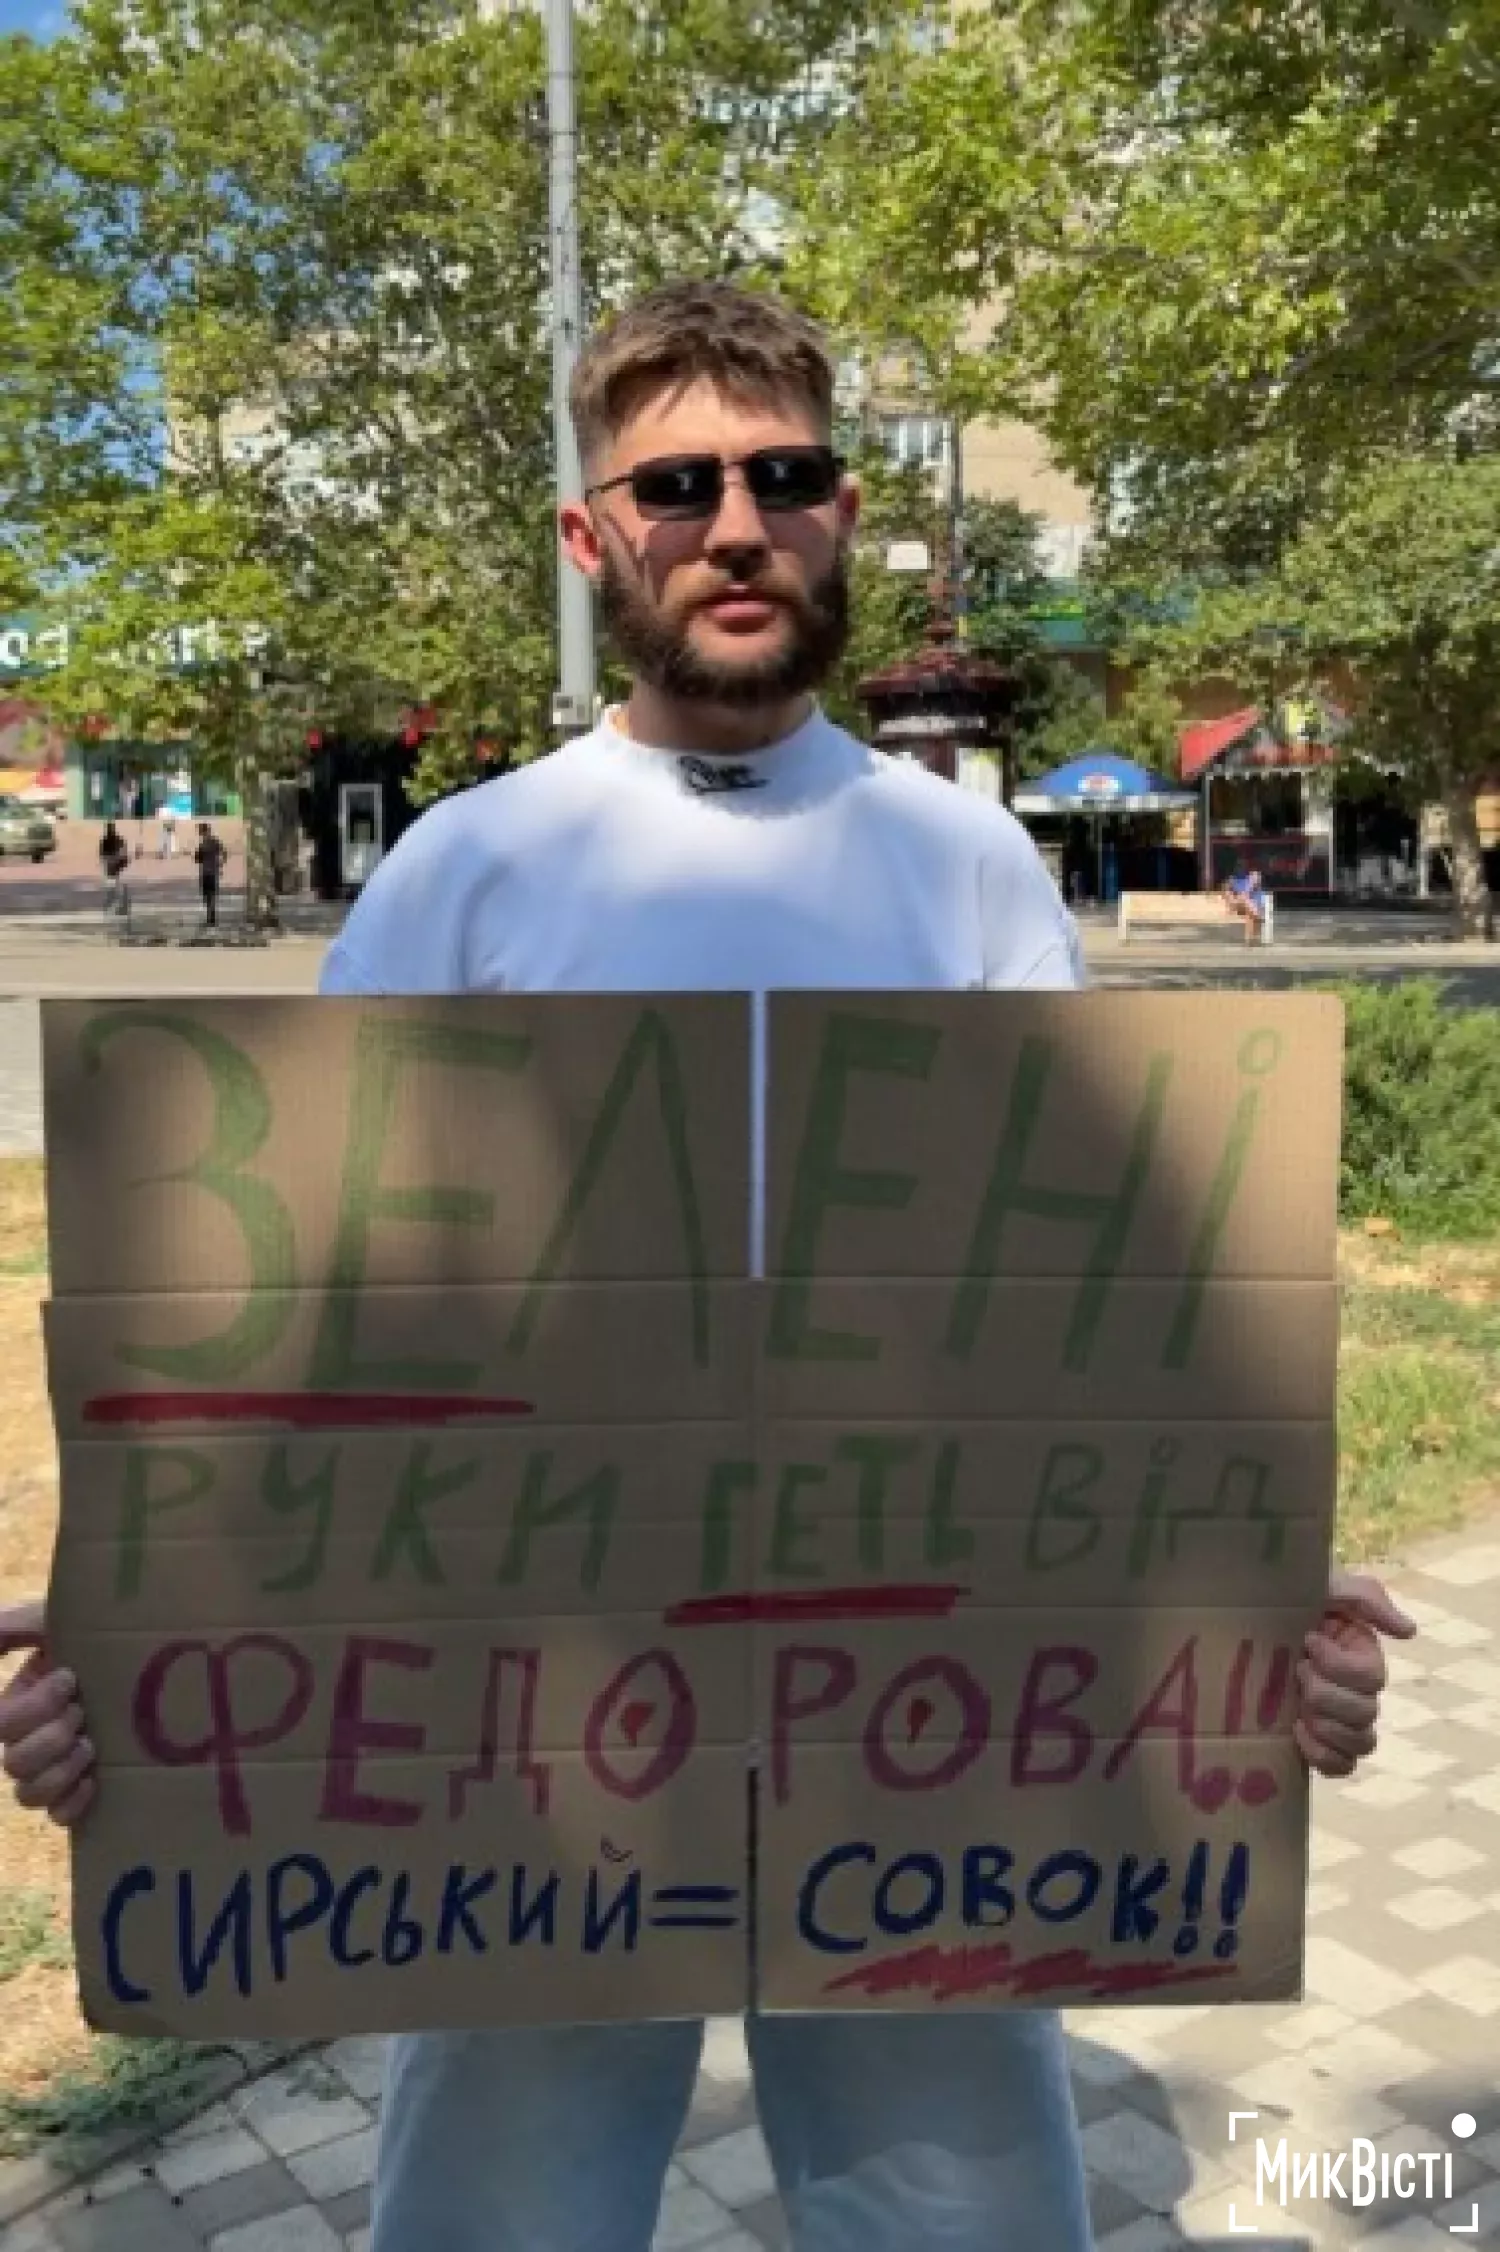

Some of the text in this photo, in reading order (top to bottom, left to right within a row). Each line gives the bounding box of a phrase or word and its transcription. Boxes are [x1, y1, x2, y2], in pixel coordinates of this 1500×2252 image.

[113, 1437, 622, 1598] РУКИ
[699, 1433, 975, 1592] ГЕТЬ
[796, 1839, 1250, 1958] СОВОК!!
